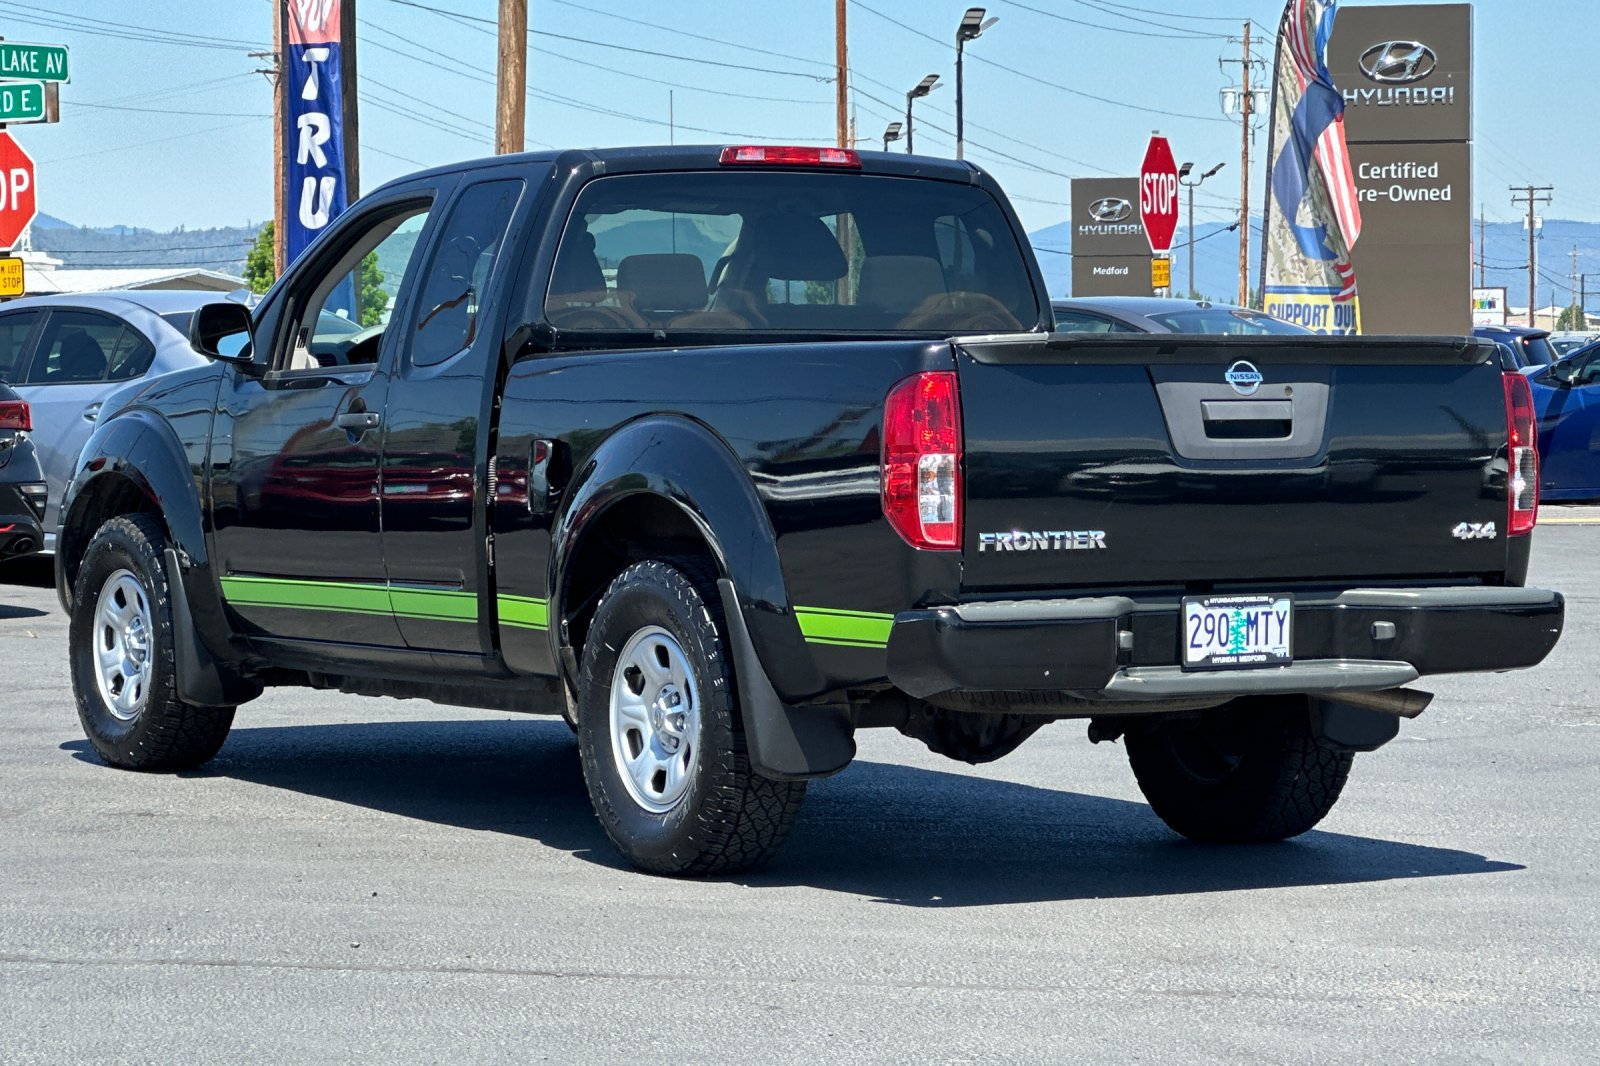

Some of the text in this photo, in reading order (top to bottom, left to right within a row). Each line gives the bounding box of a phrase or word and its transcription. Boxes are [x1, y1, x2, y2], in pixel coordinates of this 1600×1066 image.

[1, 49, 63, 74] LAKE AV
[0, 89, 37, 113] D E.
[1343, 86, 1454, 105] HYUNDAI
[1358, 161, 1439, 180] Certified
[1143, 172, 1176, 215] STOP
[1354, 184, 1452, 203] re-Owned
[1079, 224, 1142, 235] HYUNDAI
[1093, 266, 1129, 275] Medford
[3, 277, 21, 288] STOP
[1268, 303, 1329, 327] SUPPORT
[979, 530, 1107, 552] FRONTIER
[1189, 610, 1288, 649] 290 MTY
[1212, 655, 1267, 664] HYUNDAI MEDFORD
